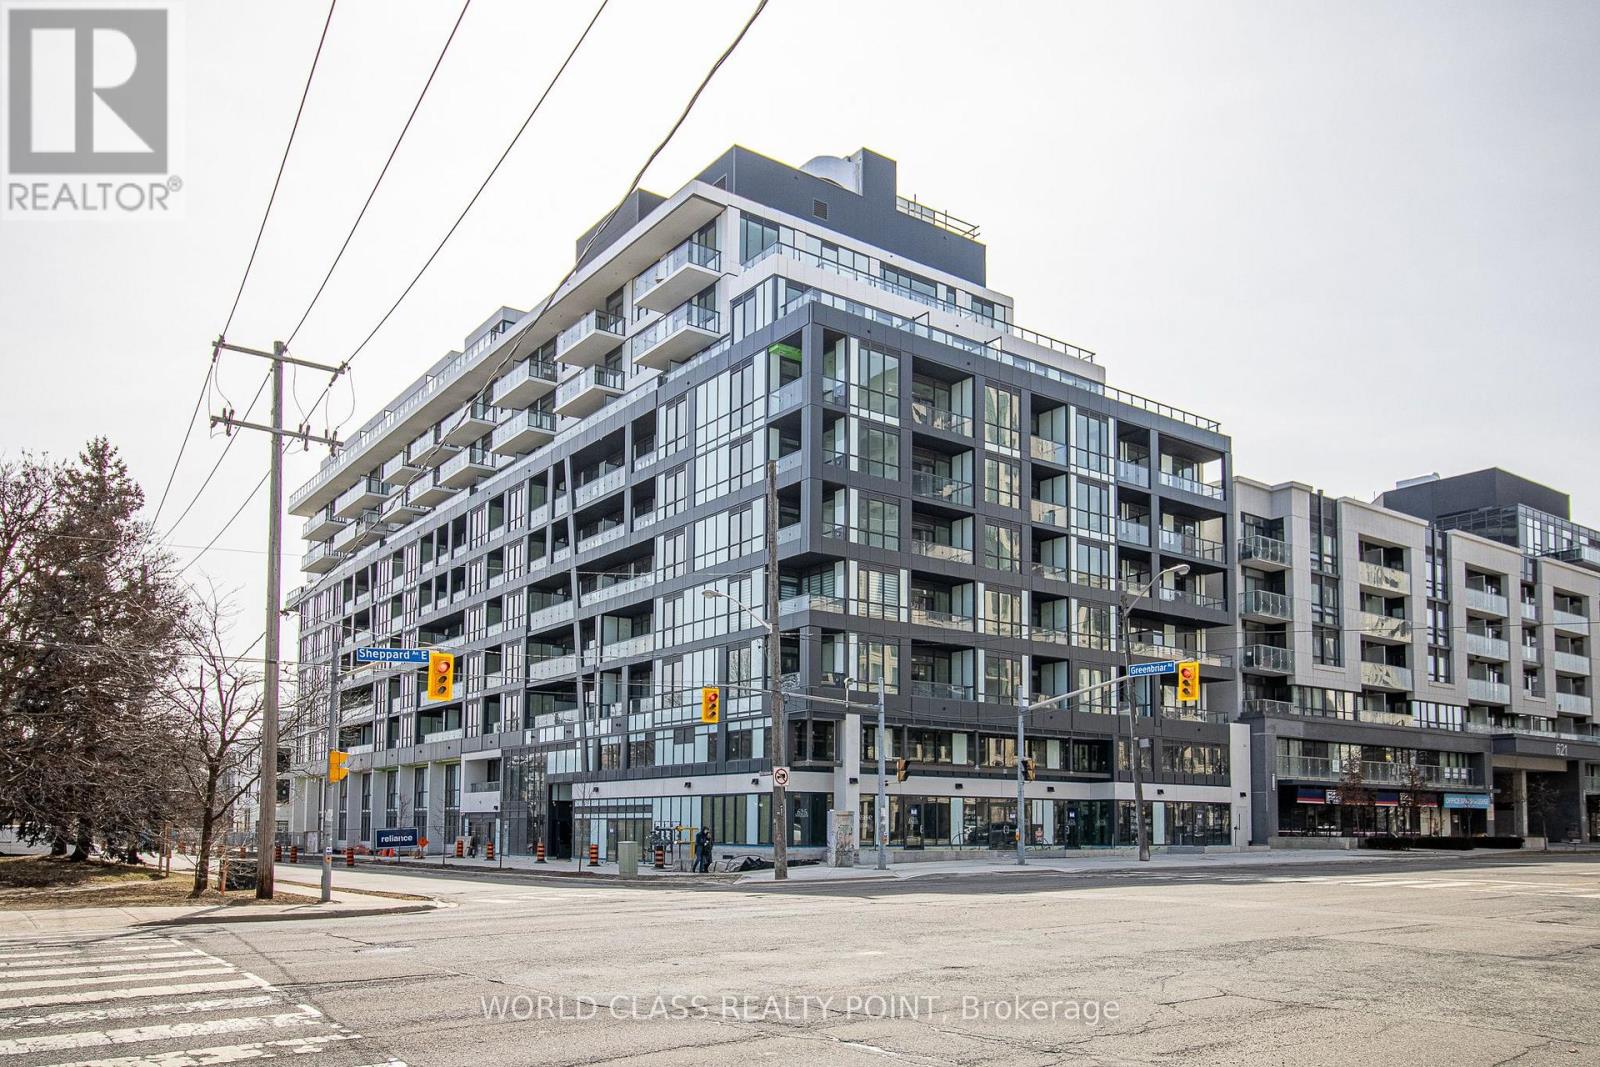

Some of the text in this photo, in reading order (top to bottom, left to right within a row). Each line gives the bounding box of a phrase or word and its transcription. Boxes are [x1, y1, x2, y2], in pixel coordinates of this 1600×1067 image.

[359, 648, 410, 660] Sheppard
[421, 651, 428, 660] E
[1130, 663, 1167, 675] Greenbriar
[1555, 743, 1568, 756] 621
[381, 835, 413, 843] reliance
